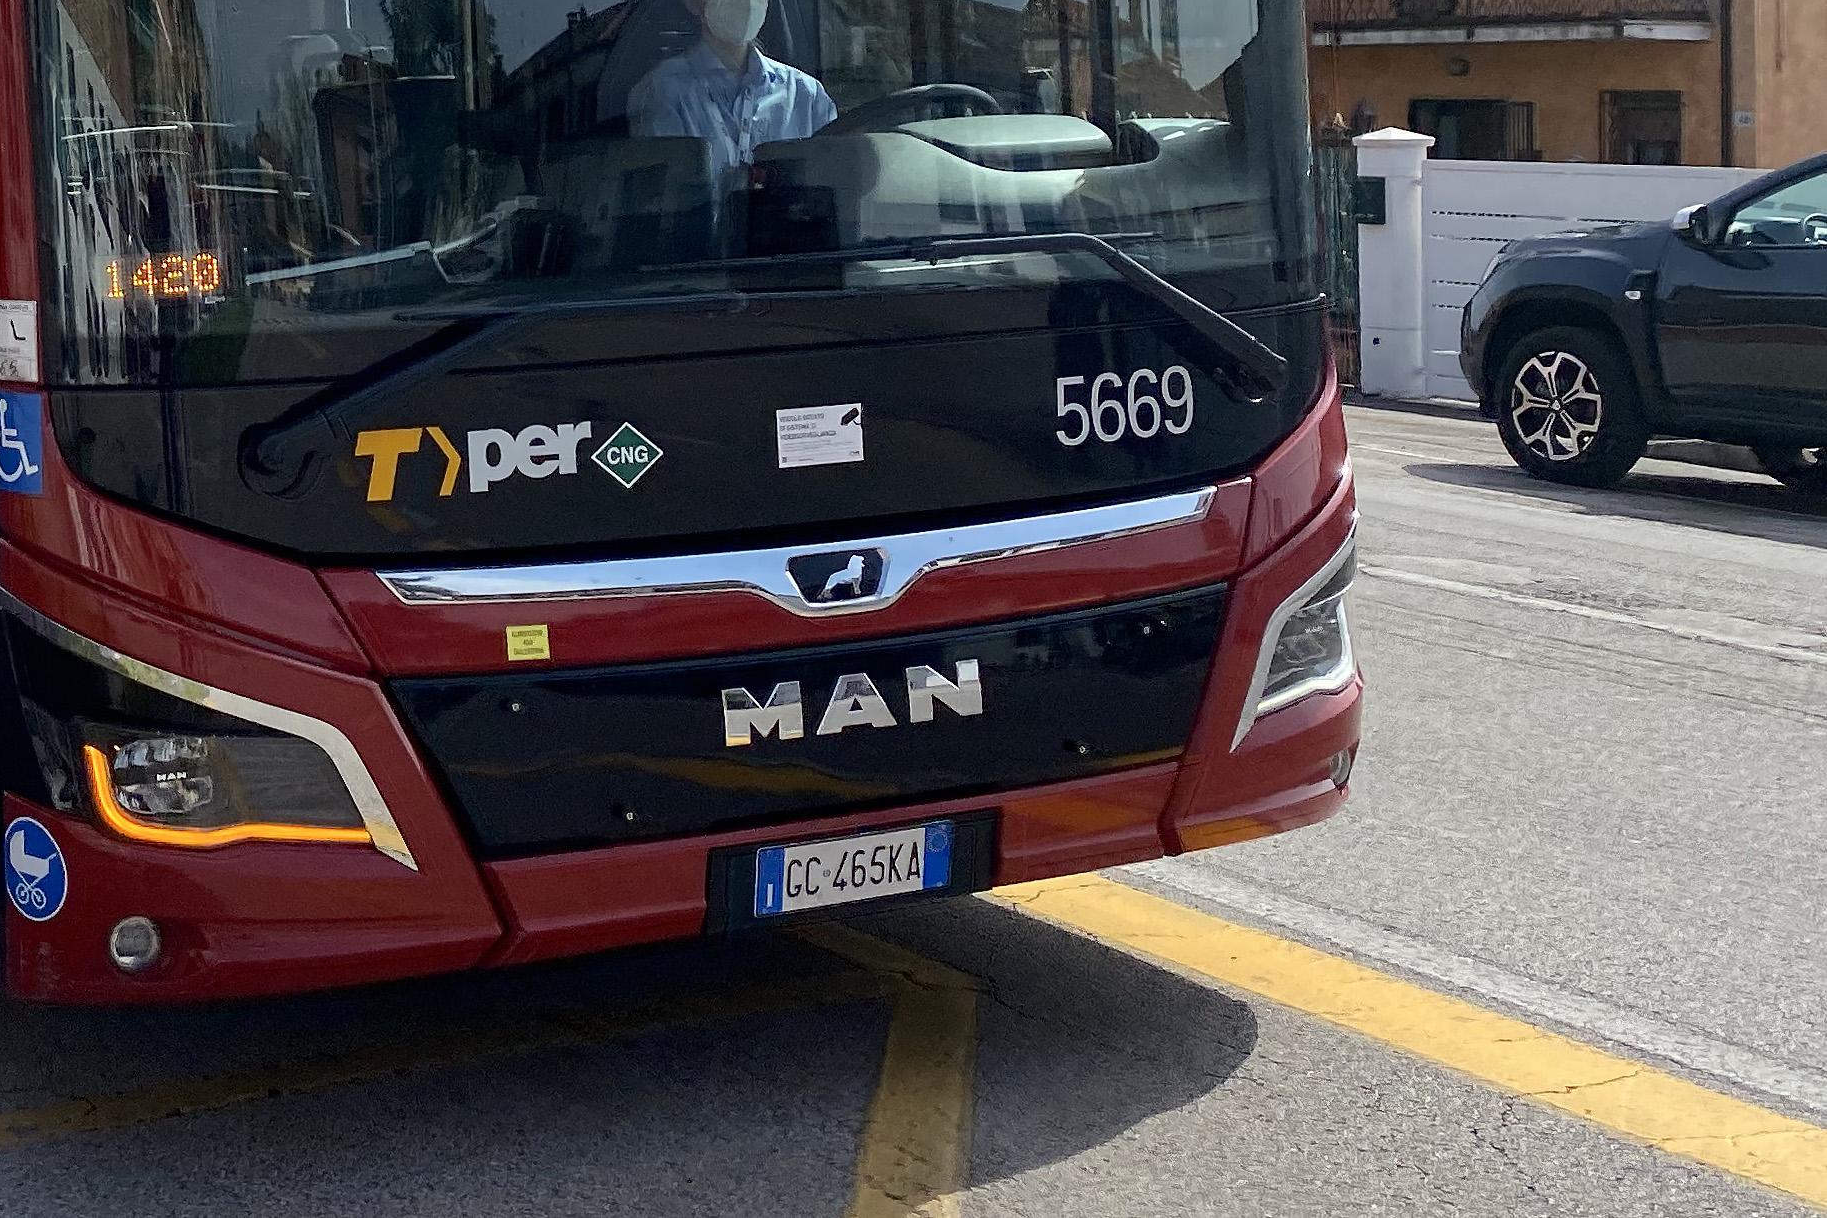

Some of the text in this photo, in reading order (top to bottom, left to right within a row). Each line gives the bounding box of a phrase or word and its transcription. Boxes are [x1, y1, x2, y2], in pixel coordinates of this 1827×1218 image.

[106, 252, 221, 298] 1420
[1056, 365, 1194, 446] 5669
[605, 445, 649, 466] CNG
[721, 658, 983, 748] MAN
